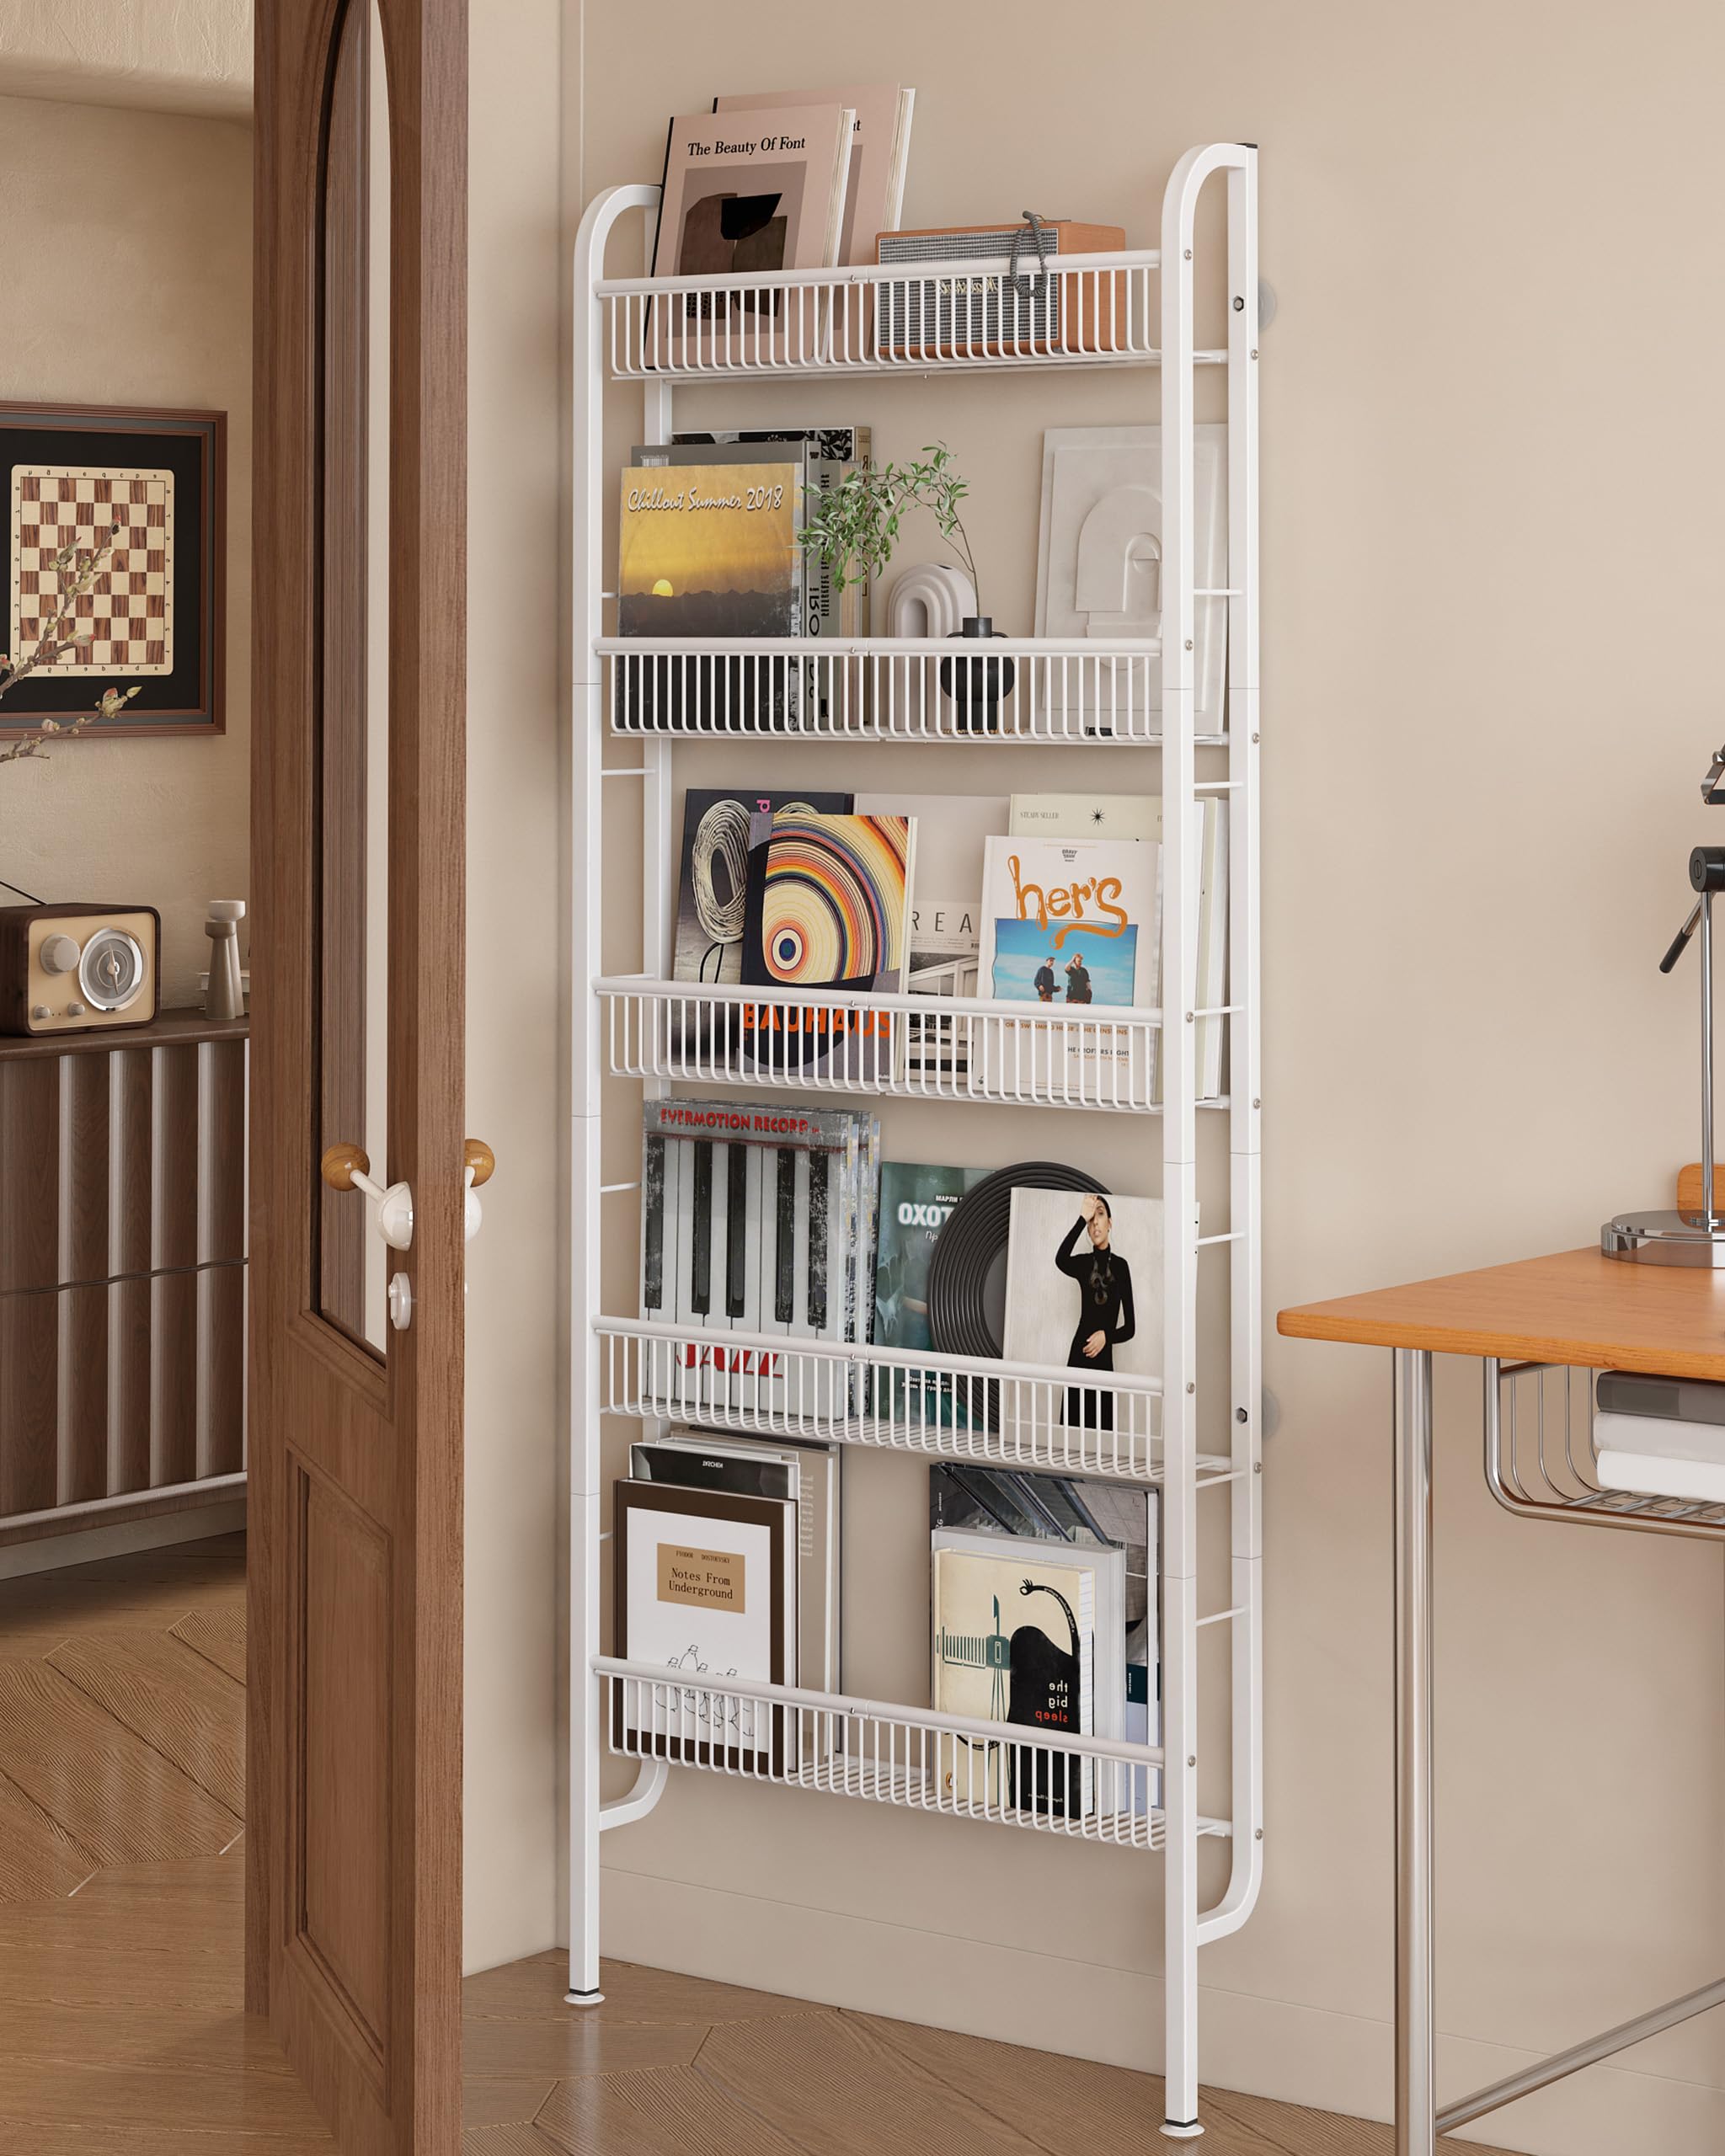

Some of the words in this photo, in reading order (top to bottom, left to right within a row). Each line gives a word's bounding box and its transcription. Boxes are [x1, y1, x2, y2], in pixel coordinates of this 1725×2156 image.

[688, 142, 711, 156] The
[714, 141, 756, 155] Beauty
[761, 137, 777, 151] Of
[779, 136, 806, 149] Font
[628, 488, 685, 511] Chillout
[688, 487, 742, 511] Summer
[746, 485, 783, 511] 2018
[1008, 855, 1128, 950] her's
[744, 1003, 890, 1038] BAUHAUS
[660, 1108, 750, 1129] EVERMOTION
[672, 1567, 701, 1582] Notes
[707, 1572, 731, 1586] From
[669, 1580, 733, 1599] Underground
